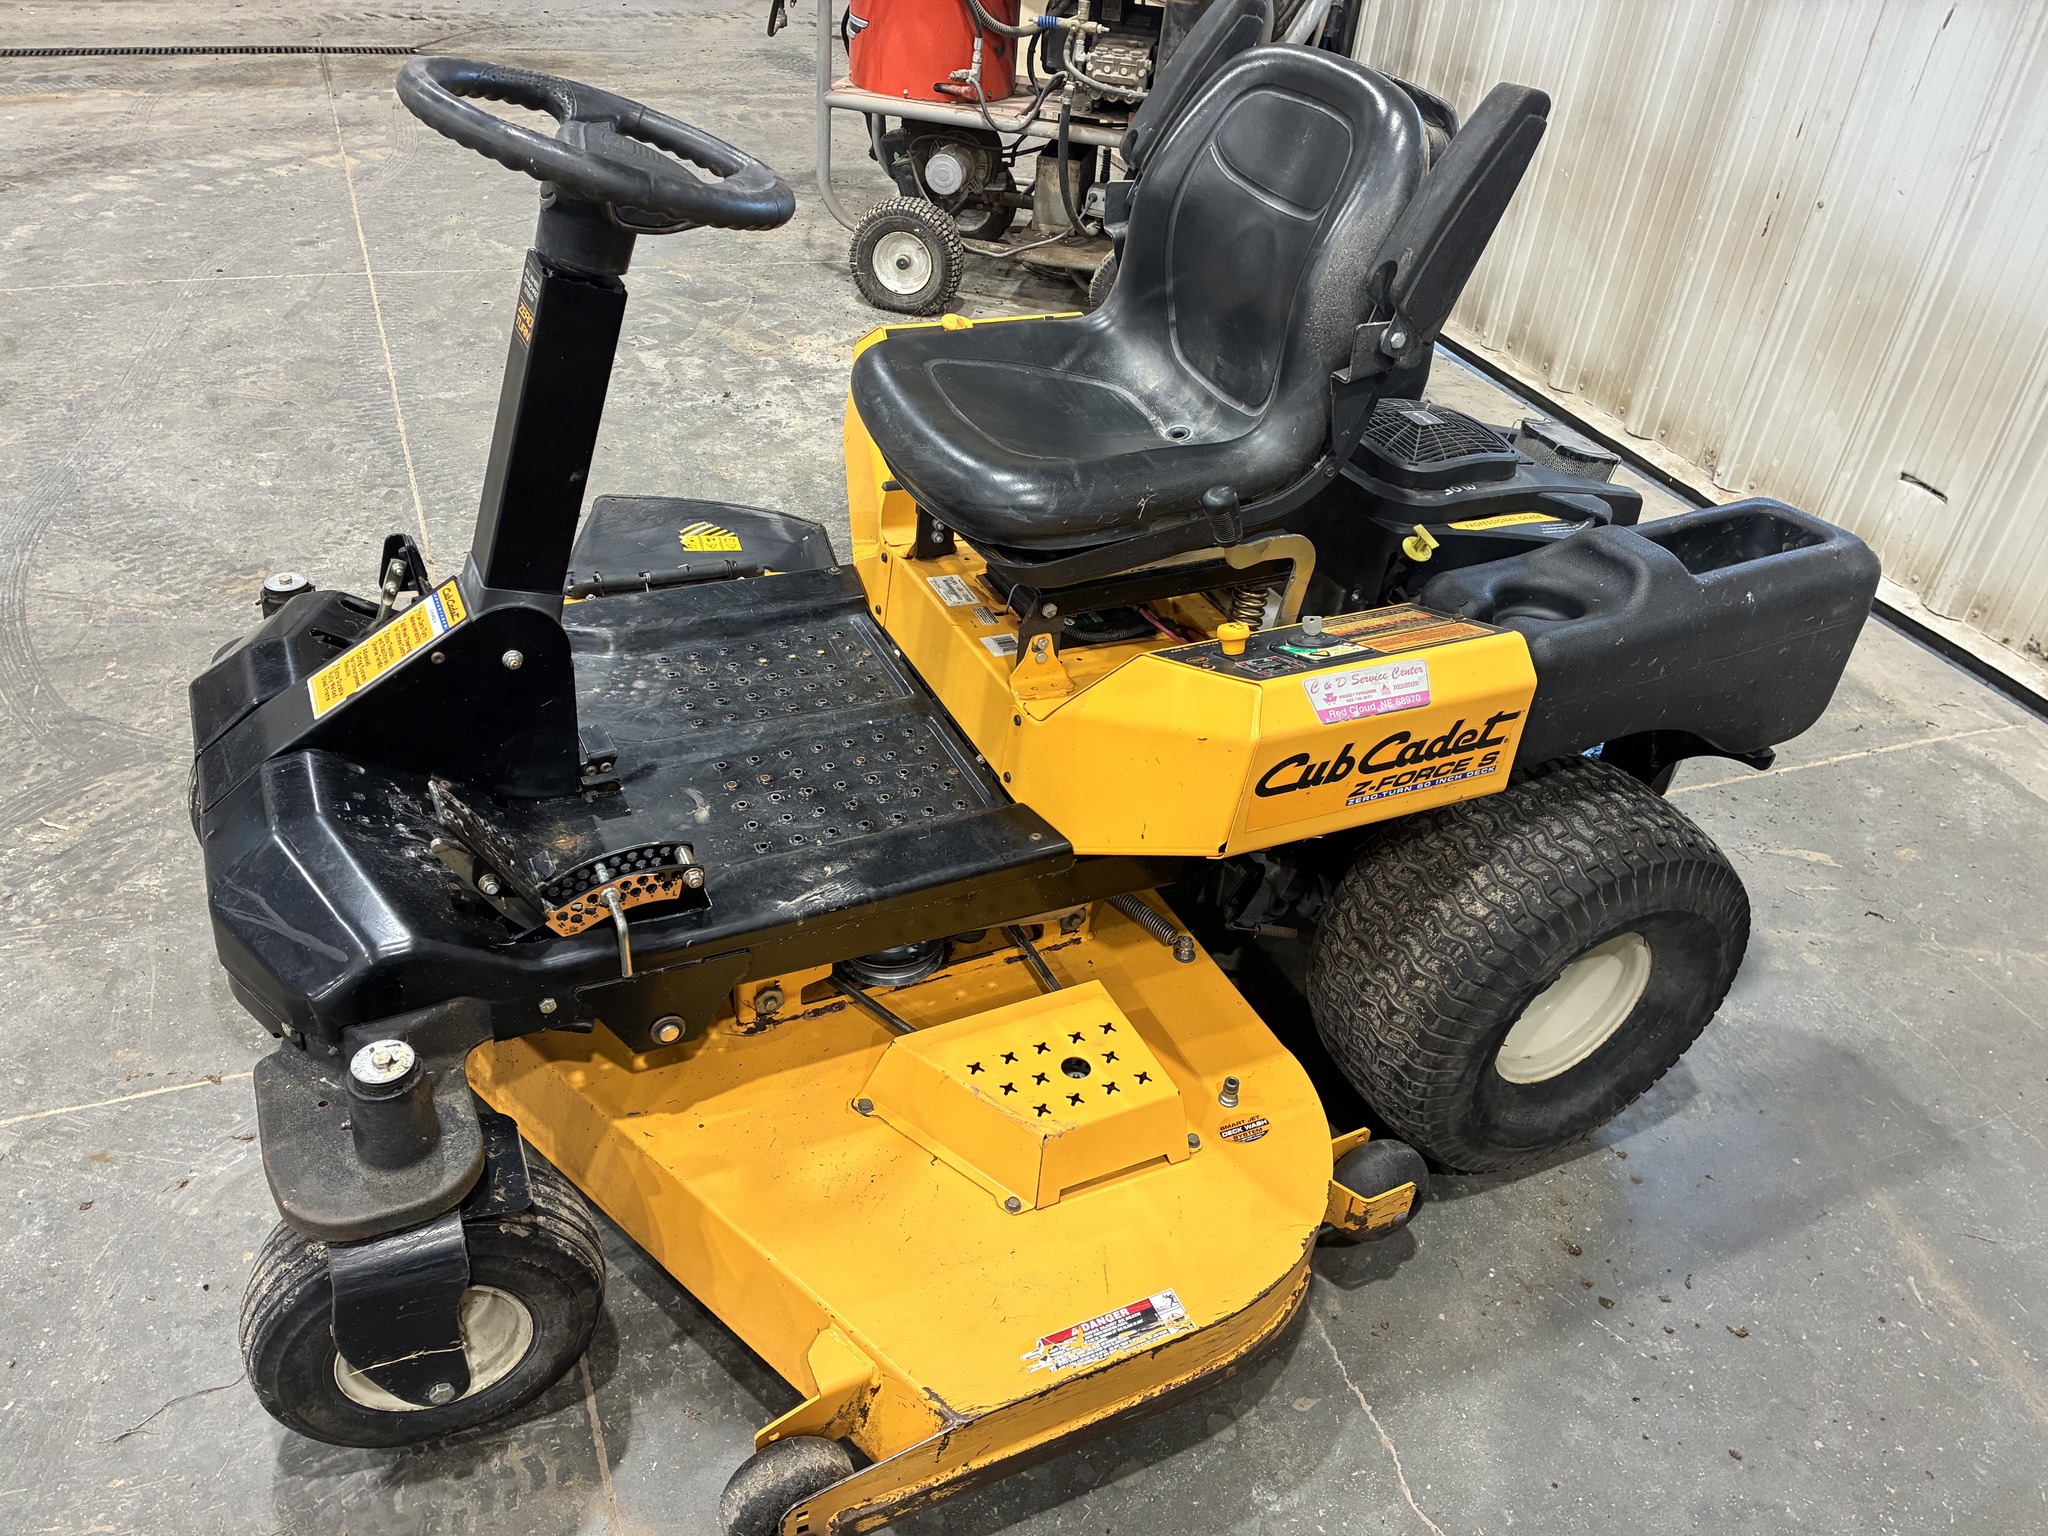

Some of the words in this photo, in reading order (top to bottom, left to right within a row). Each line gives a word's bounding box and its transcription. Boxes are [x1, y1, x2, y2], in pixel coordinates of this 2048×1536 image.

[518, 302, 533, 328] ZERO
[516, 314, 531, 342] TURN
[1464, 517, 1518, 529] PROFESSIONAL
[1518, 514, 1543, 522] GRADE
[1310, 680, 1320, 694] C
[1323, 681, 1332, 690] &
[1335, 676, 1347, 688] D
[1351, 672, 1388, 685] Service
[1391, 666, 1424, 679] Center
[1328, 707, 1347, 719] Red
[1379, 700, 1392, 709] NE
[1395, 694, 1421, 705] 68970
[1254, 742, 1356, 798] Cub
[1357, 710, 1522, 775] Cadet
[1347, 757, 1474, 798] Z-FORCE
[1477, 750, 1500, 768] S
[1416, 781, 1431, 790] 60
[1435, 774, 1462, 785] INCH
[1465, 766, 1496, 778] DECK
[1220, 1119, 1246, 1131] SMART
[1247, 1115, 1260, 1123] JET
[1221, 1126, 1244, 1138] DECK
[1244, 1119, 1268, 1131] WASH
[1232, 1127, 1263, 1140] SYSTEM
[1080, 1308, 1129, 1331] DANGER
